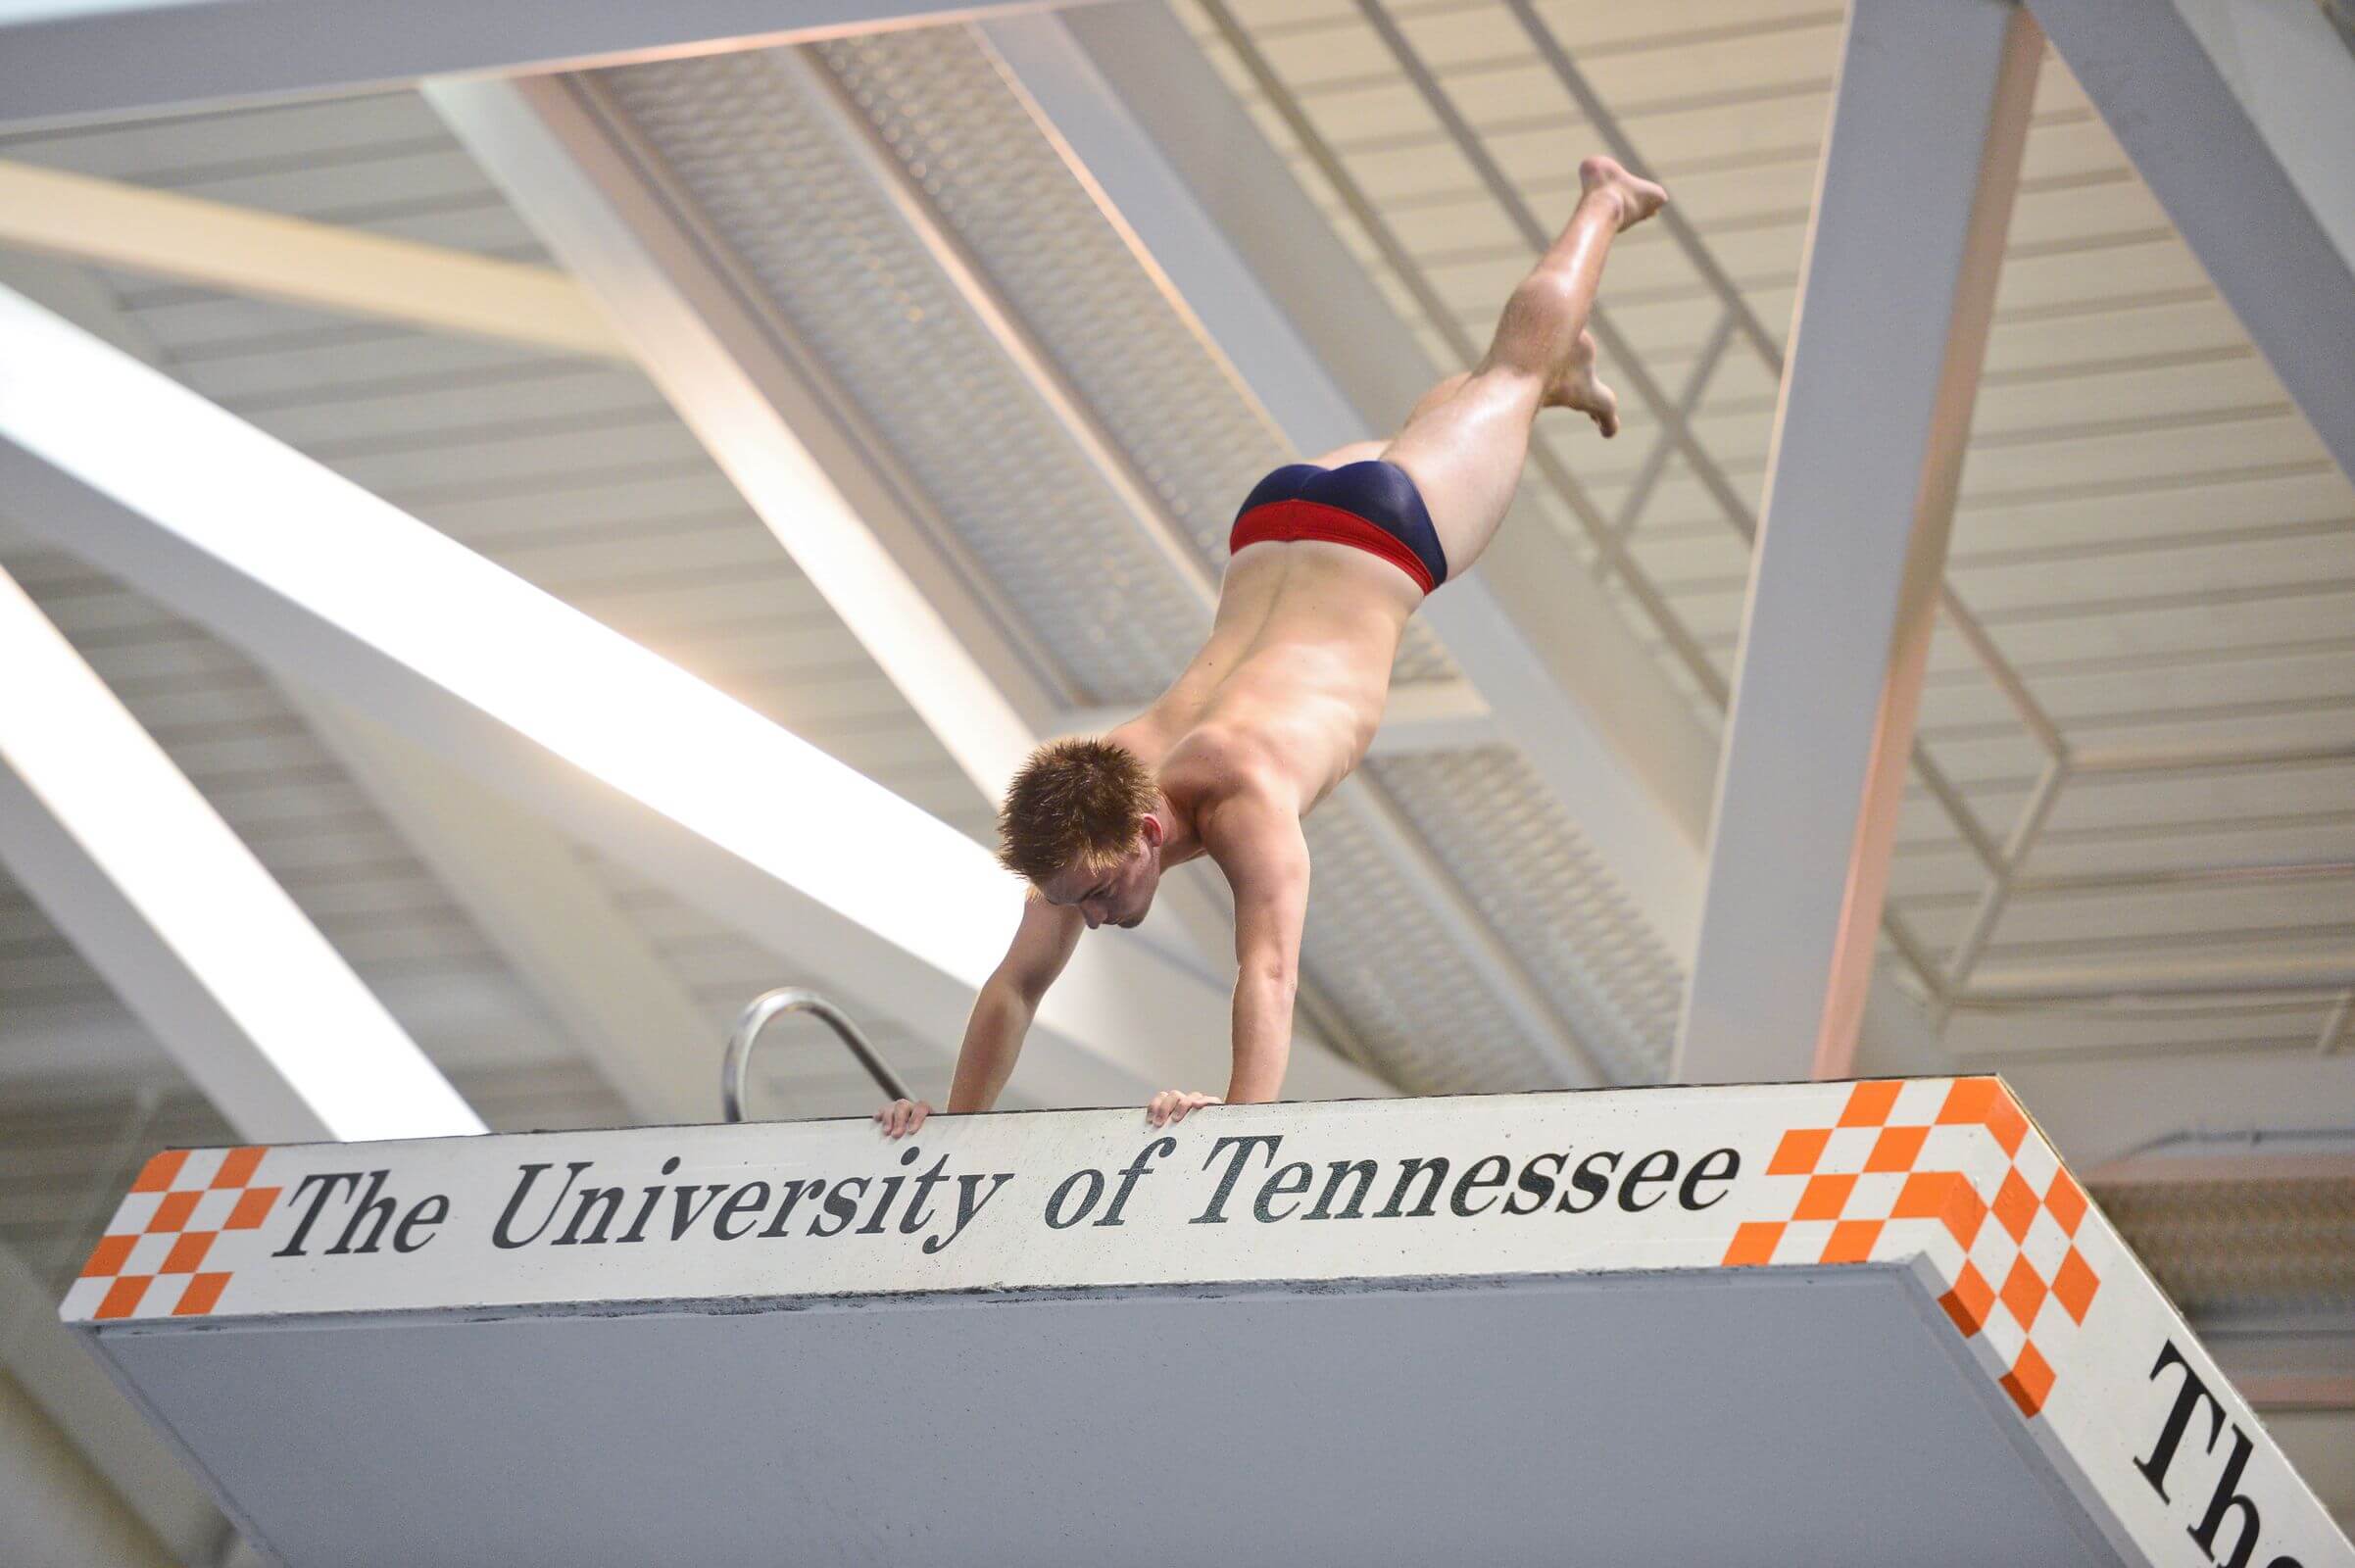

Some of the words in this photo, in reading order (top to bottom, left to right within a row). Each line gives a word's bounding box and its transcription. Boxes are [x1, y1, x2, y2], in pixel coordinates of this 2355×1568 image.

[271, 1168, 451, 1259] The
[492, 1146, 1016, 1254] University
[1045, 1135, 1177, 1231] of
[1189, 1134, 1742, 1225] Tennessee
[2133, 1338, 2305, 1568] Th
